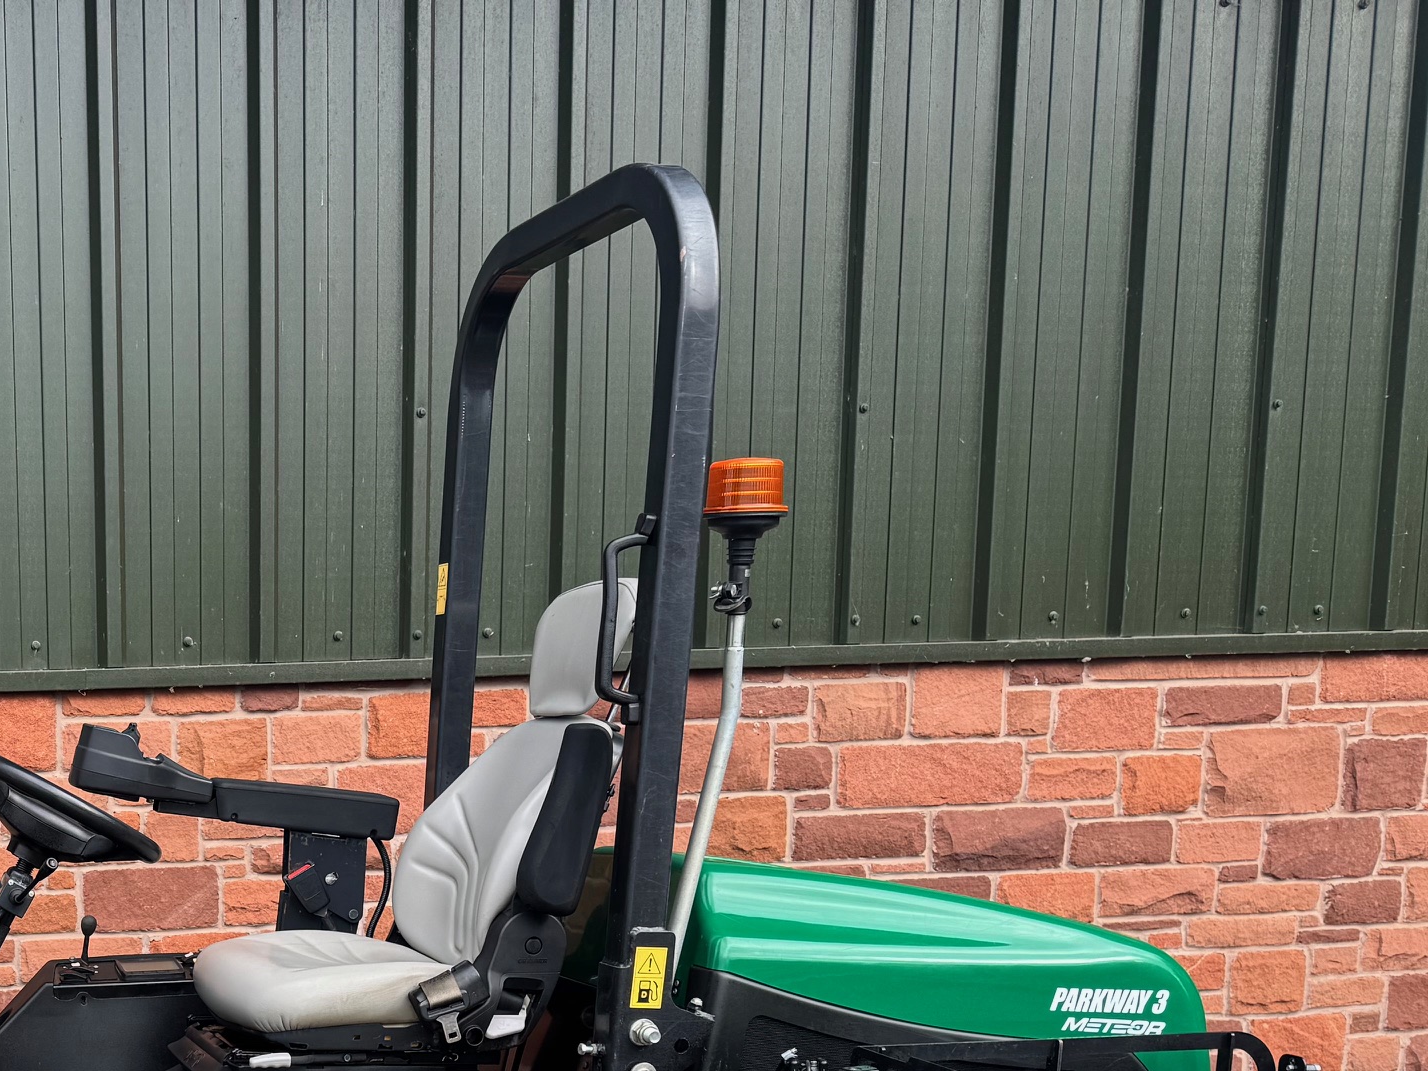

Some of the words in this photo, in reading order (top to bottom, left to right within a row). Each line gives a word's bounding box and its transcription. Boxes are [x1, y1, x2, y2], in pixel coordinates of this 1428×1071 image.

[1049, 987, 1154, 1014] PARKWAY
[1151, 989, 1170, 1015] 3
[1060, 1016, 1167, 1036] METEOR
